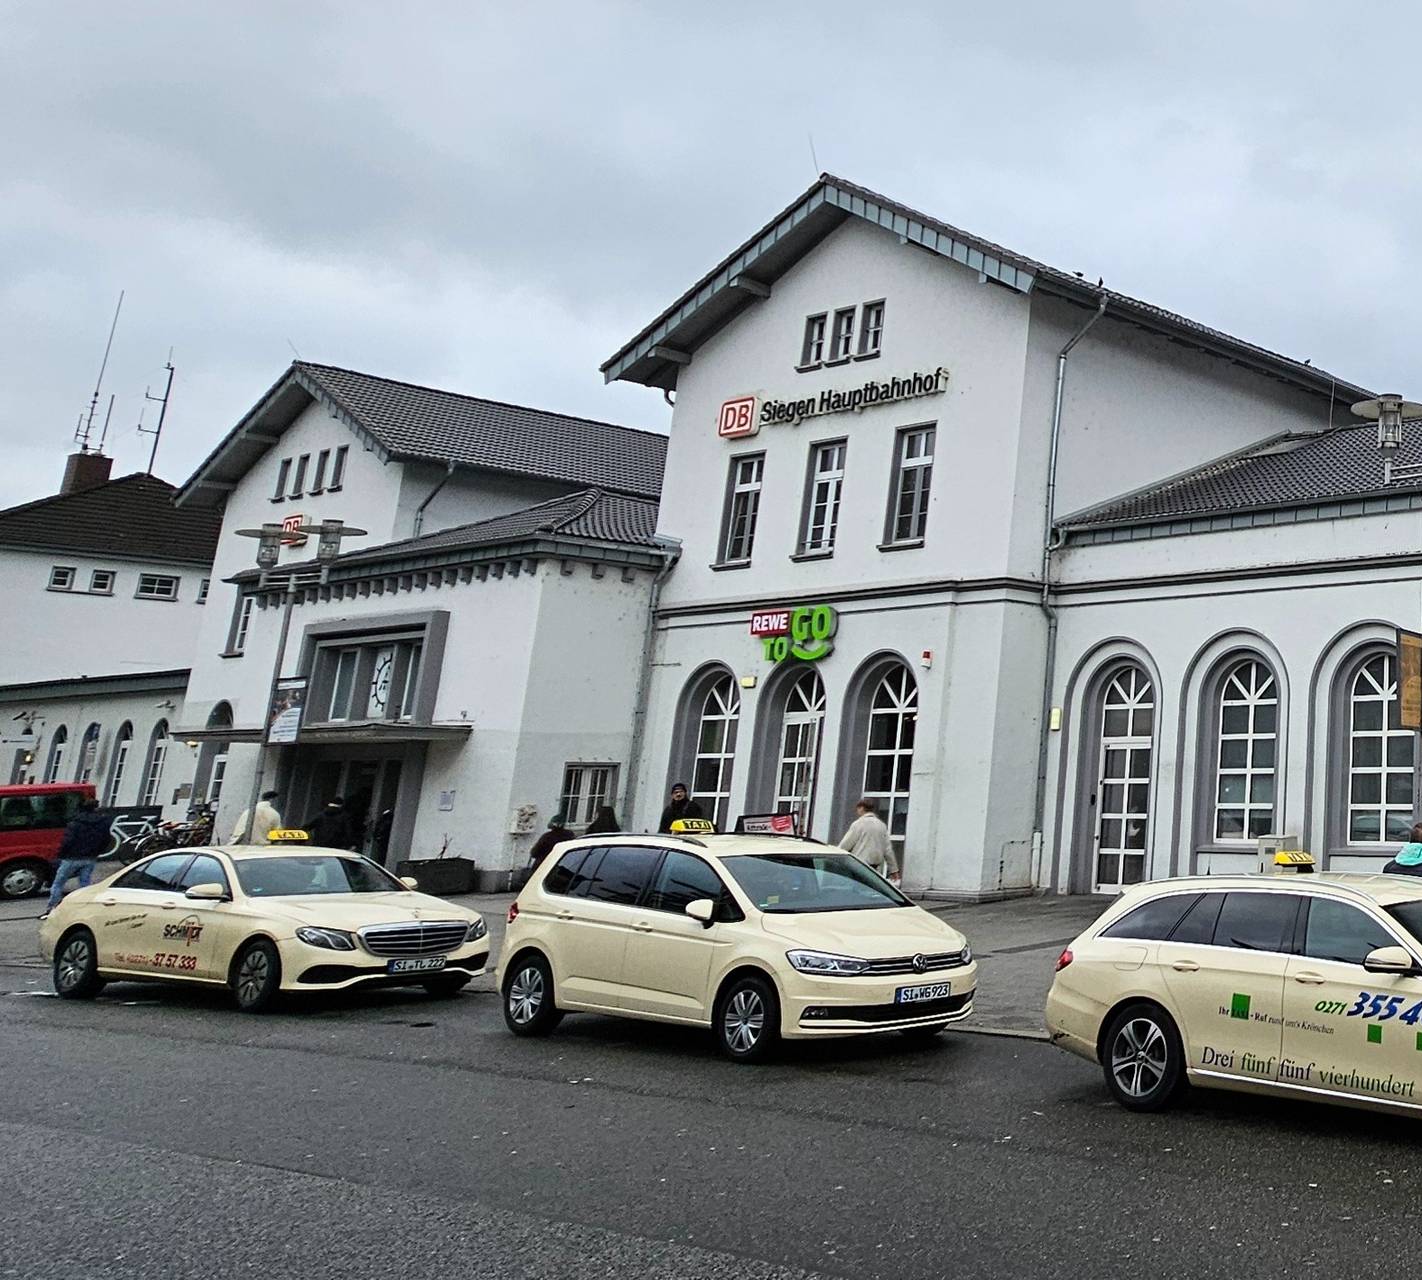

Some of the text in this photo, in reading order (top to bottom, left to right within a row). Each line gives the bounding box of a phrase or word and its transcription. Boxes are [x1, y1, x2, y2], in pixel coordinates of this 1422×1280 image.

[723, 366, 944, 431] DB Siegen Hauptbahnhof
[752, 613, 789, 632] REWE
[791, 604, 832, 641] GO
[762, 636, 788, 662] TO
[685, 821, 710, 830] TAXI
[166, 953, 178, 969] 57
[179, 955, 198, 971] 333
[395, 961, 407, 970] SI
[903, 989, 914, 1001] SI
[931, 984, 949, 997] 923
[1219, 1006, 1230, 1016] Ihr
[1254, 1012, 1268, 1022] Ruf
[1268, 1016, 1285, 1026] rund
[1314, 1000, 1348, 1016] 0271
[1201, 1046, 1416, 1098] Drei fünf fünf vierhundert
